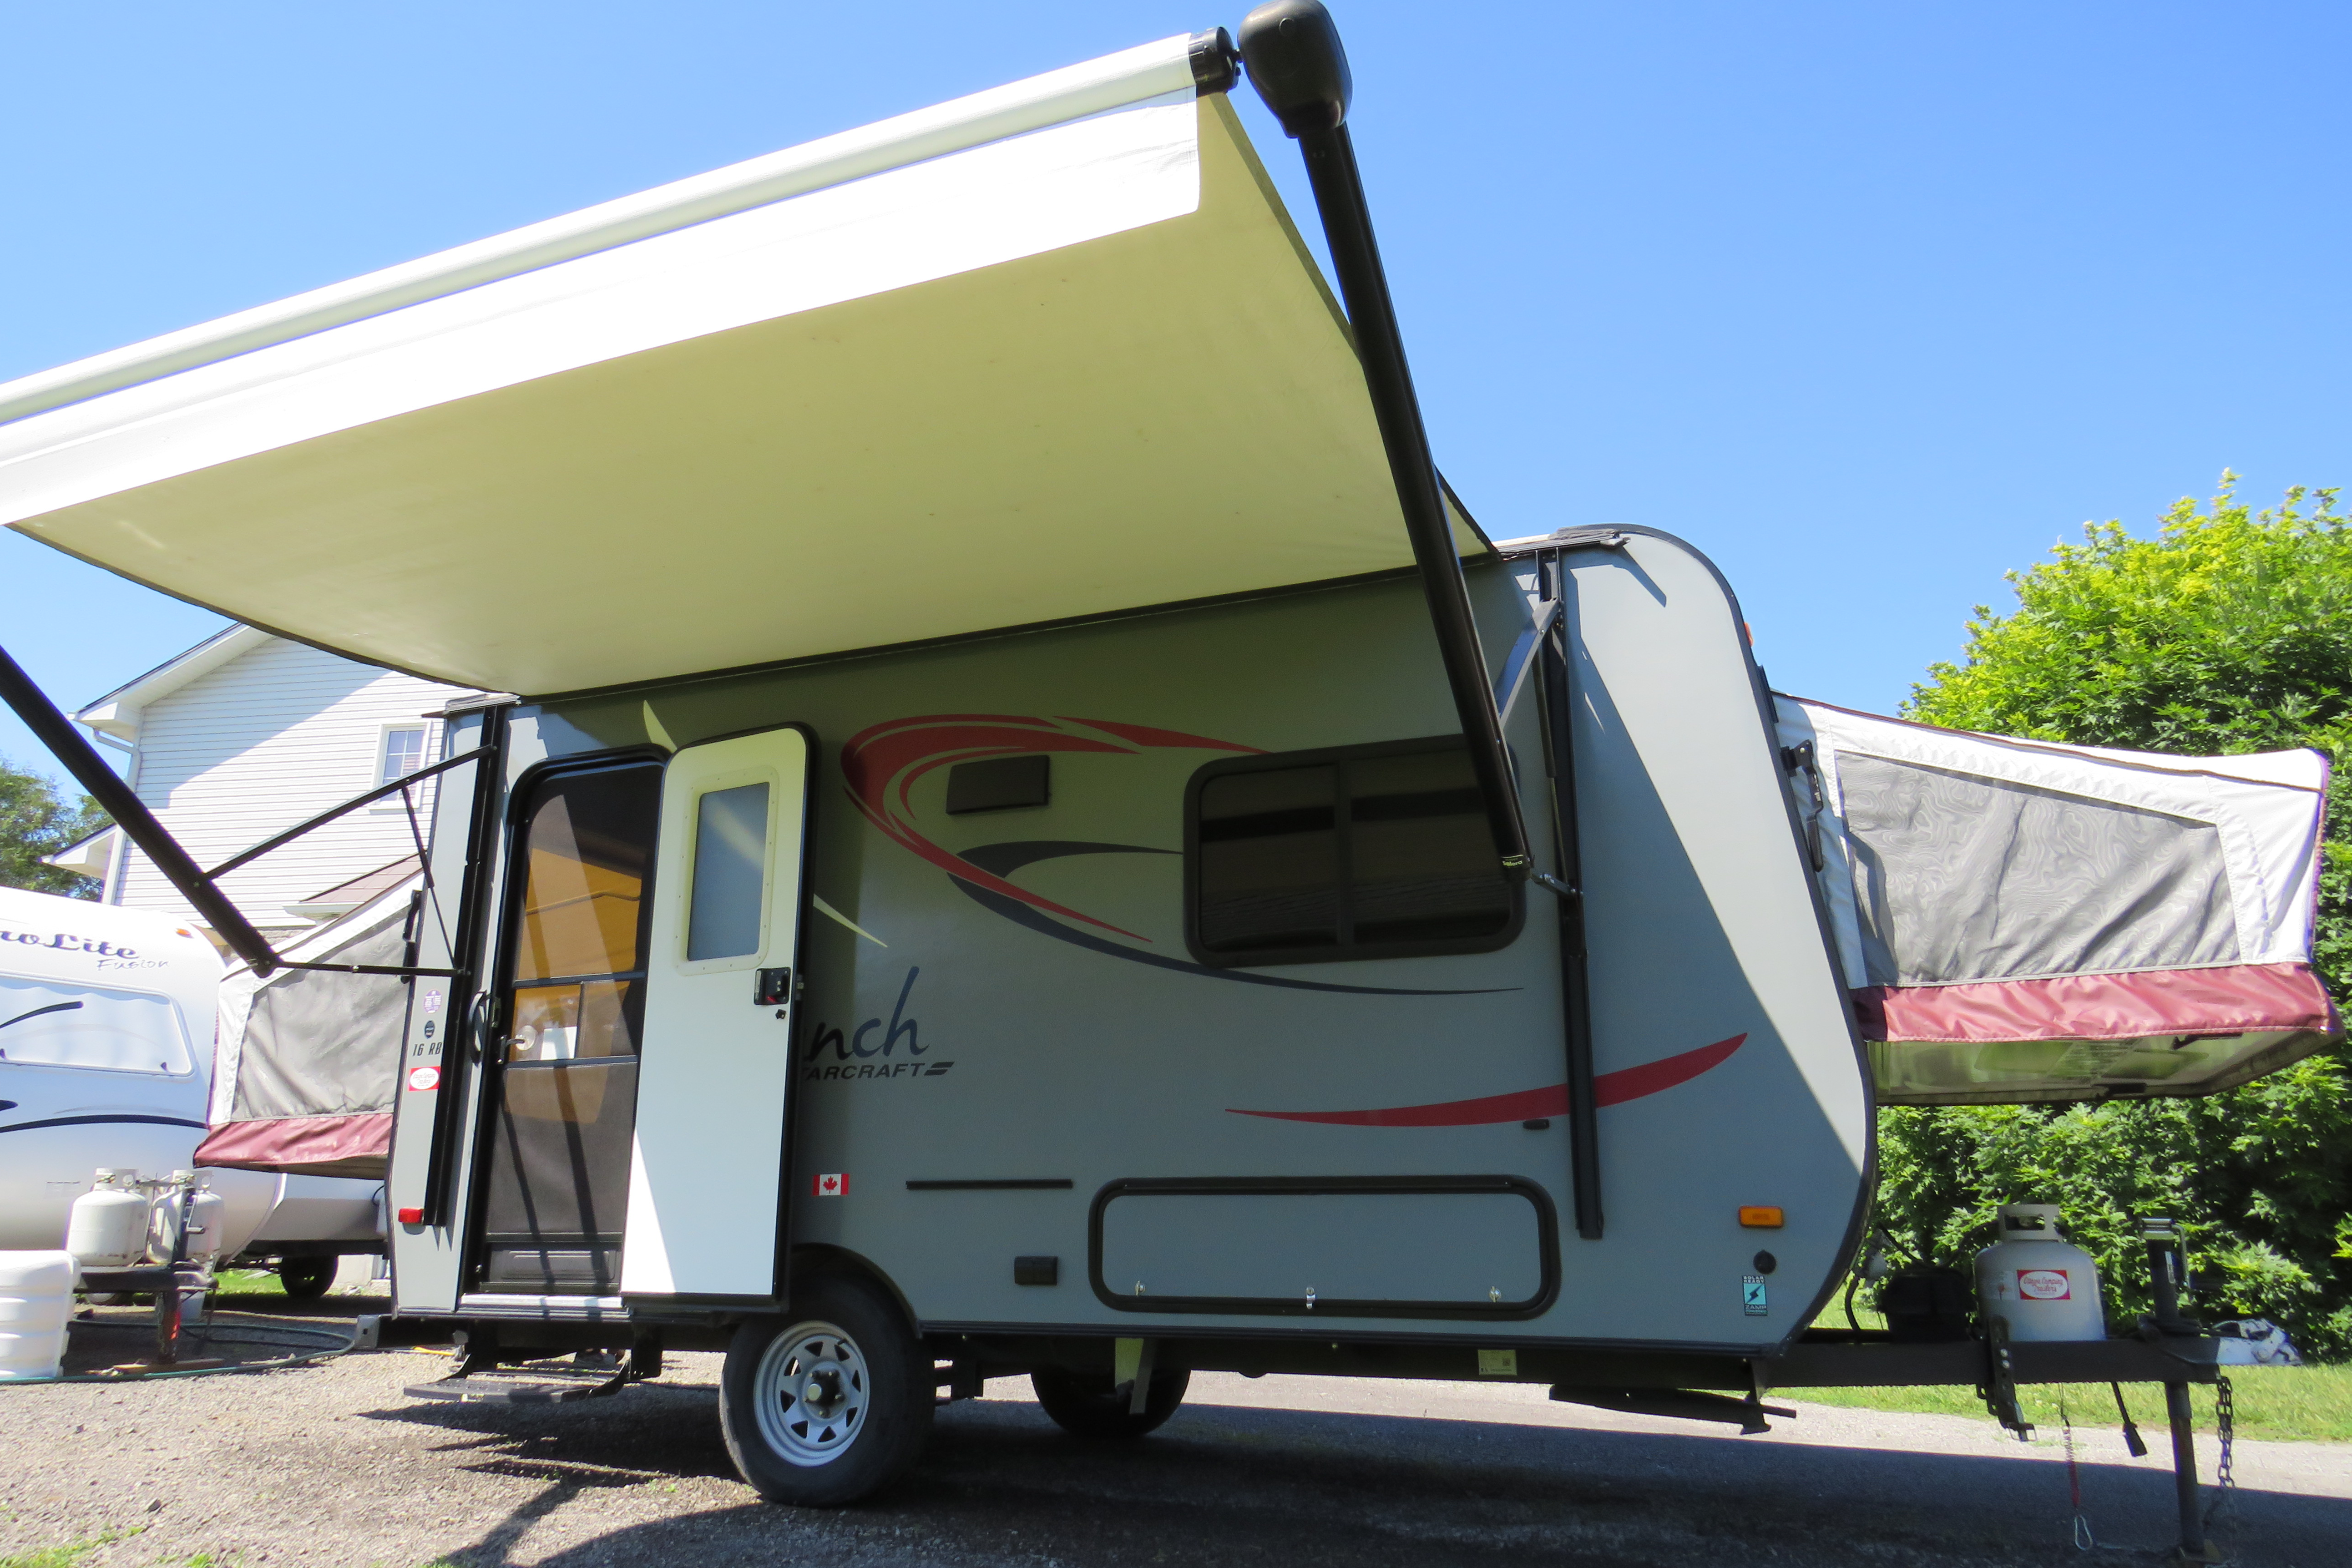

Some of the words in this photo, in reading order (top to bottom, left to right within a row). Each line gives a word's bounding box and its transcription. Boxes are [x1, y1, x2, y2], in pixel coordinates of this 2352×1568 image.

[96, 959, 170, 971] Fusion
[803, 966, 930, 1062] nch
[413, 1043, 425, 1056] 16
[429, 1042, 442, 1055] RB
